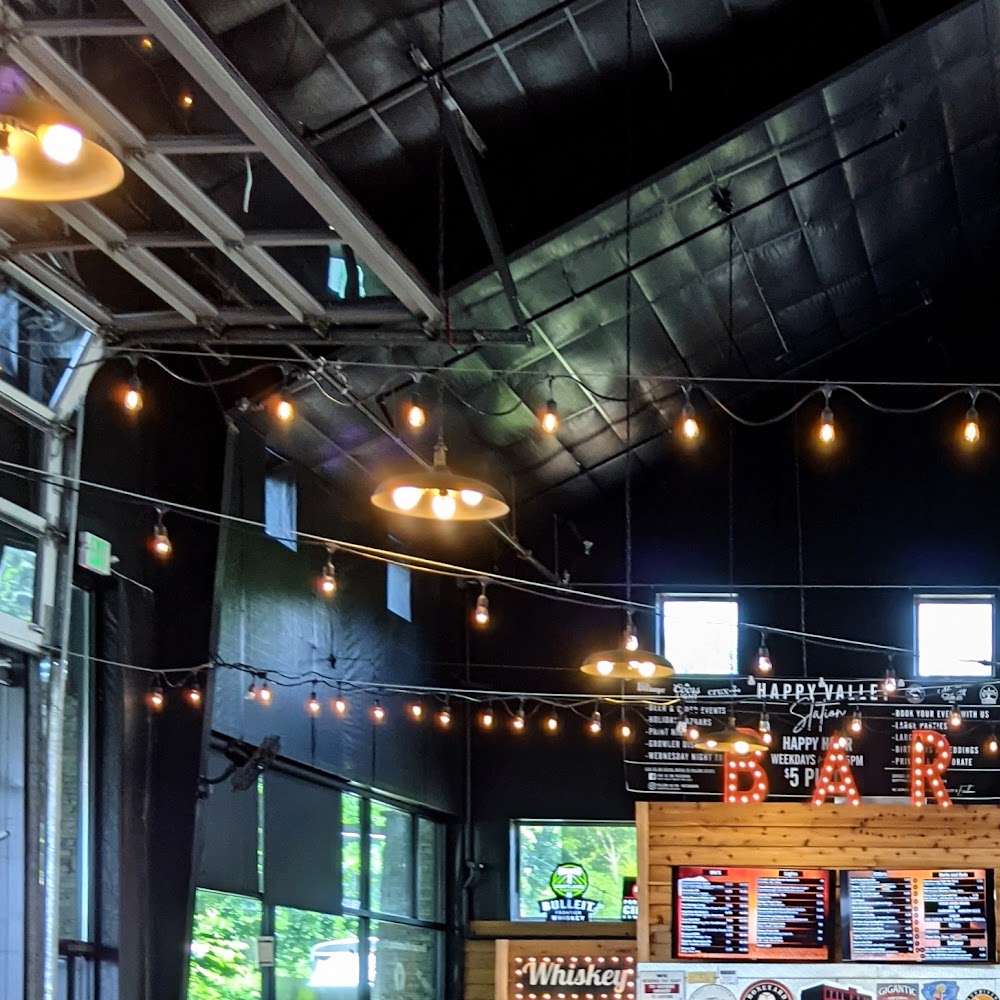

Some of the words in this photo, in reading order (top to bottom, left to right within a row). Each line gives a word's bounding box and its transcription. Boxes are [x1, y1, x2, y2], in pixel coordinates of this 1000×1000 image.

[757, 683, 816, 700] HAPPY
[789, 697, 846, 733] Station
[783, 737, 819, 751] HAPPY
[821, 737, 853, 751] HR
[950, 746, 979, 754] EDDINGS
[771, 753, 816, 765] WEEKDAYS
[784, 767, 799, 787] $5
[541, 899, 596, 911] BULLEIT
[522, 961, 629, 993] Whiskey
[747, 984, 787, 1000] BONEYARD
[878, 984, 917, 997] GIGANTIC
